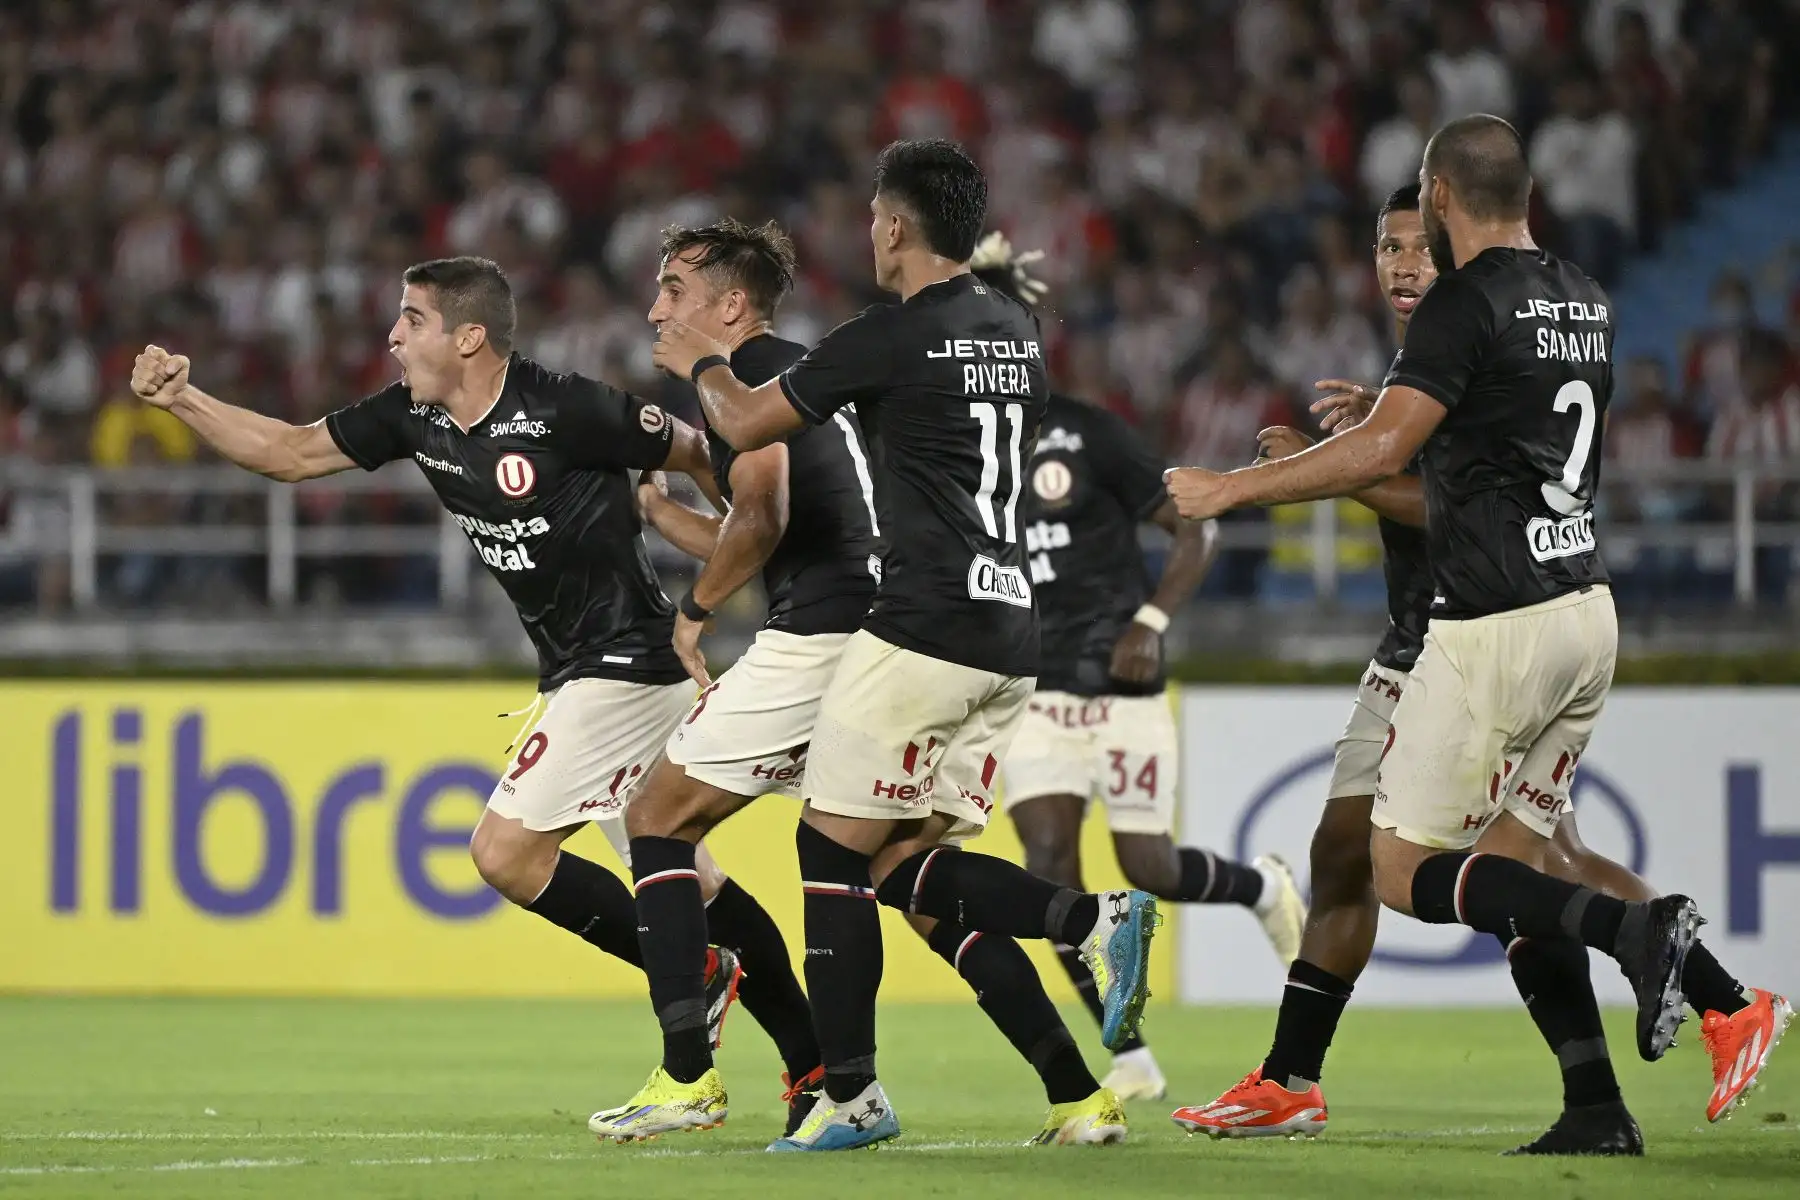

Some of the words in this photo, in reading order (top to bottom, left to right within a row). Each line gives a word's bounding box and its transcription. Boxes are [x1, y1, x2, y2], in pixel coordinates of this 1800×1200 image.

[1515, 299, 1608, 323] JETOUR
[926, 340, 1040, 358] JETOUR
[963, 364, 1030, 394] RIVERA
[416, 451, 463, 475] marathon
[1541, 380, 1595, 517] 2
[503, 461, 526, 492] U
[969, 403, 1023, 543] 11
[509, 732, 548, 781] 9
[1107, 749, 1157, 800] 34
[50, 708, 506, 920] libre
